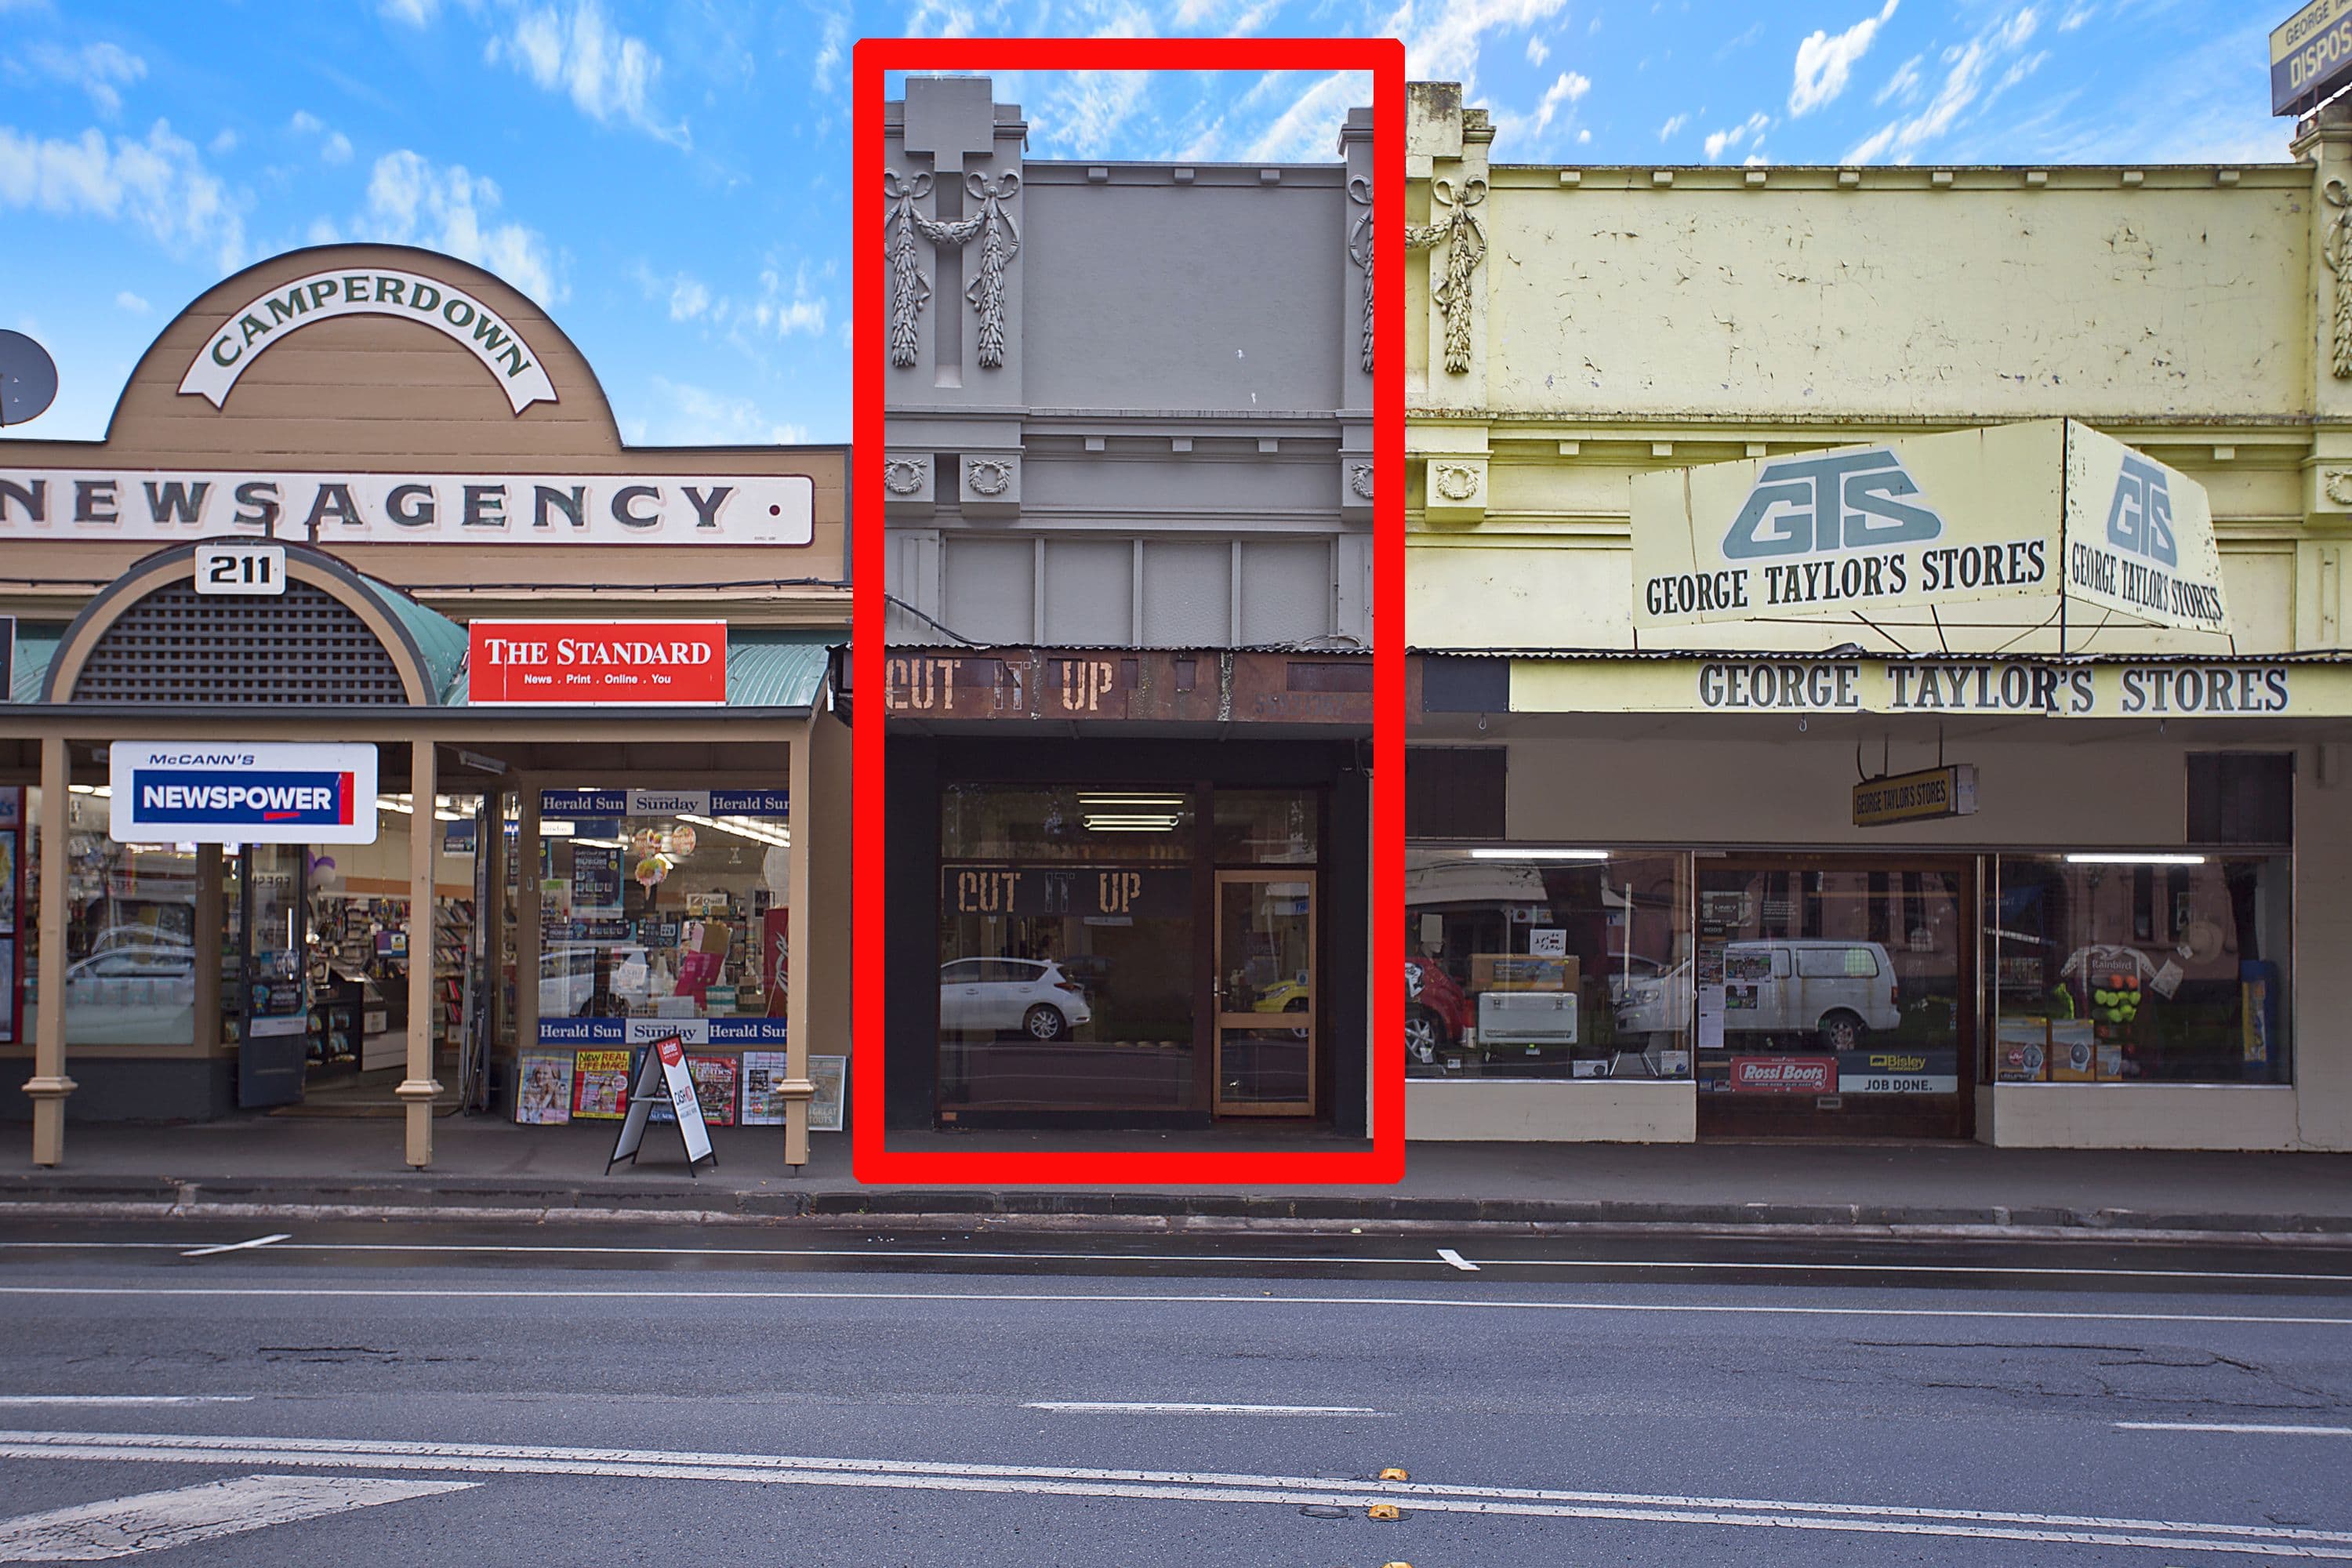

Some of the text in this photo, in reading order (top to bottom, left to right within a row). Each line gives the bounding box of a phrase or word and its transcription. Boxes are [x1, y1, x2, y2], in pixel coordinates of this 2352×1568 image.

[2285, 2, 2329, 46] GEORGE
[211, 275, 532, 379] CAMPERDOWN
[0, 479, 735, 529] NEWSAGENCY
[1722, 449, 1943, 559] GTS
[2107, 454, 2178, 568] GTS
[209, 556, 270, 584] 211
[1646, 540, 2045, 615] GEORGE TAYLOR'S STORES
[2072, 542, 2223, 622] GEORGE TAYLOR'S STORES
[485, 637, 712, 665] THE STANDARD
[524, 674, 671, 684] News Print Online You
[885, 659, 961, 710] CUT
[1062, 660, 1112, 710] UP
[1700, 664, 2288, 713] GEORGE TAYLOR'S STORES
[148, 753, 255, 766] McCANN'S
[143, 786, 332, 811] NEWSPOWER
[543, 796, 625, 810] Herald Sun
[636, 797, 699, 812] Sunday
[712, 796, 760, 810] Herald
[1857, 790, 1882, 815] GEORGE
[1917, 779, 1946, 806] STORES
[958, 872, 1141, 913] CUT IT UP
[2092, 959, 2133, 971] Rainbird
[539, 1024, 622, 1038] Herald Sun
[634, 1025, 697, 1040] Sunday
[710, 1024, 758, 1038] Herald
[602, 1052, 628, 1062] REAL
[1888, 1055, 1926, 1069] Bisley
[1744, 1064, 1824, 1080] Rossi Boots
[1864, 1080, 1933, 1091] JOB DONE.
